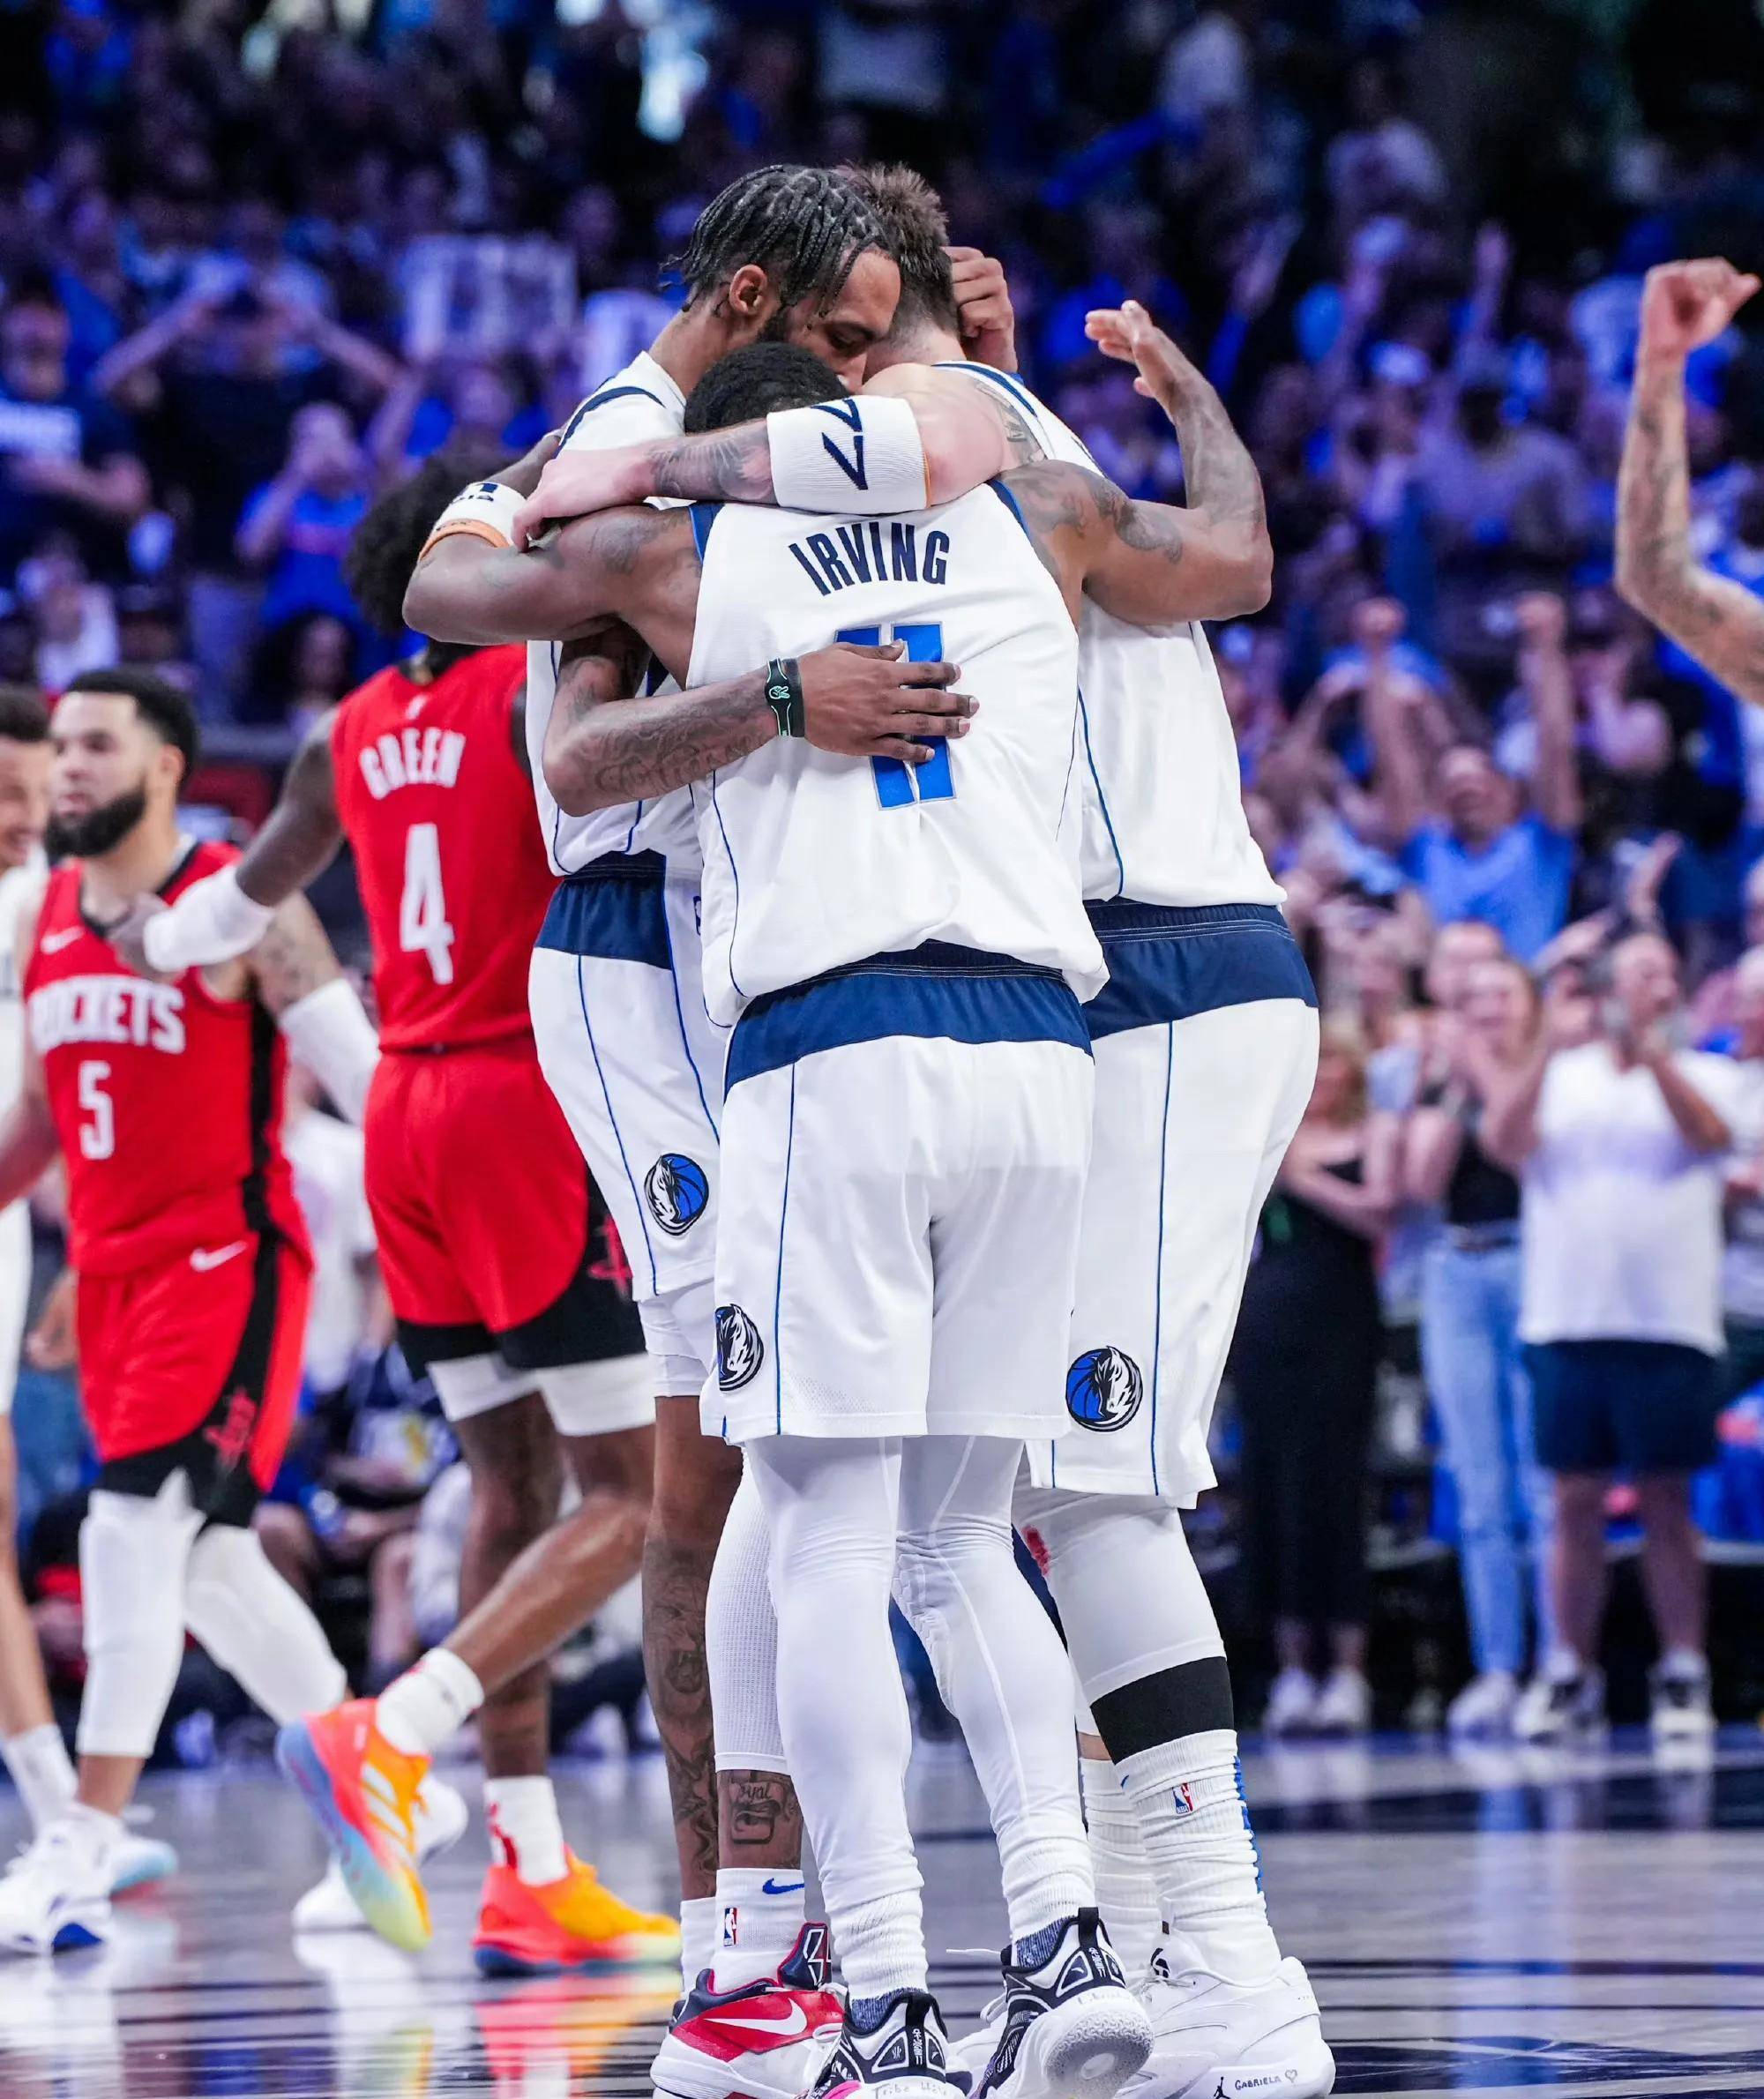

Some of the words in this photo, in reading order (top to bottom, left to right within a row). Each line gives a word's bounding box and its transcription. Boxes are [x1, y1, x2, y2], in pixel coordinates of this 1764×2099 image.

[788, 521, 950, 596] IRVING
[358, 727, 467, 801] GREEN
[399, 821, 455, 985] 4
[78, 1059, 116, 1161] 5
[1234, 2075, 1282, 2091] GABRIELA
